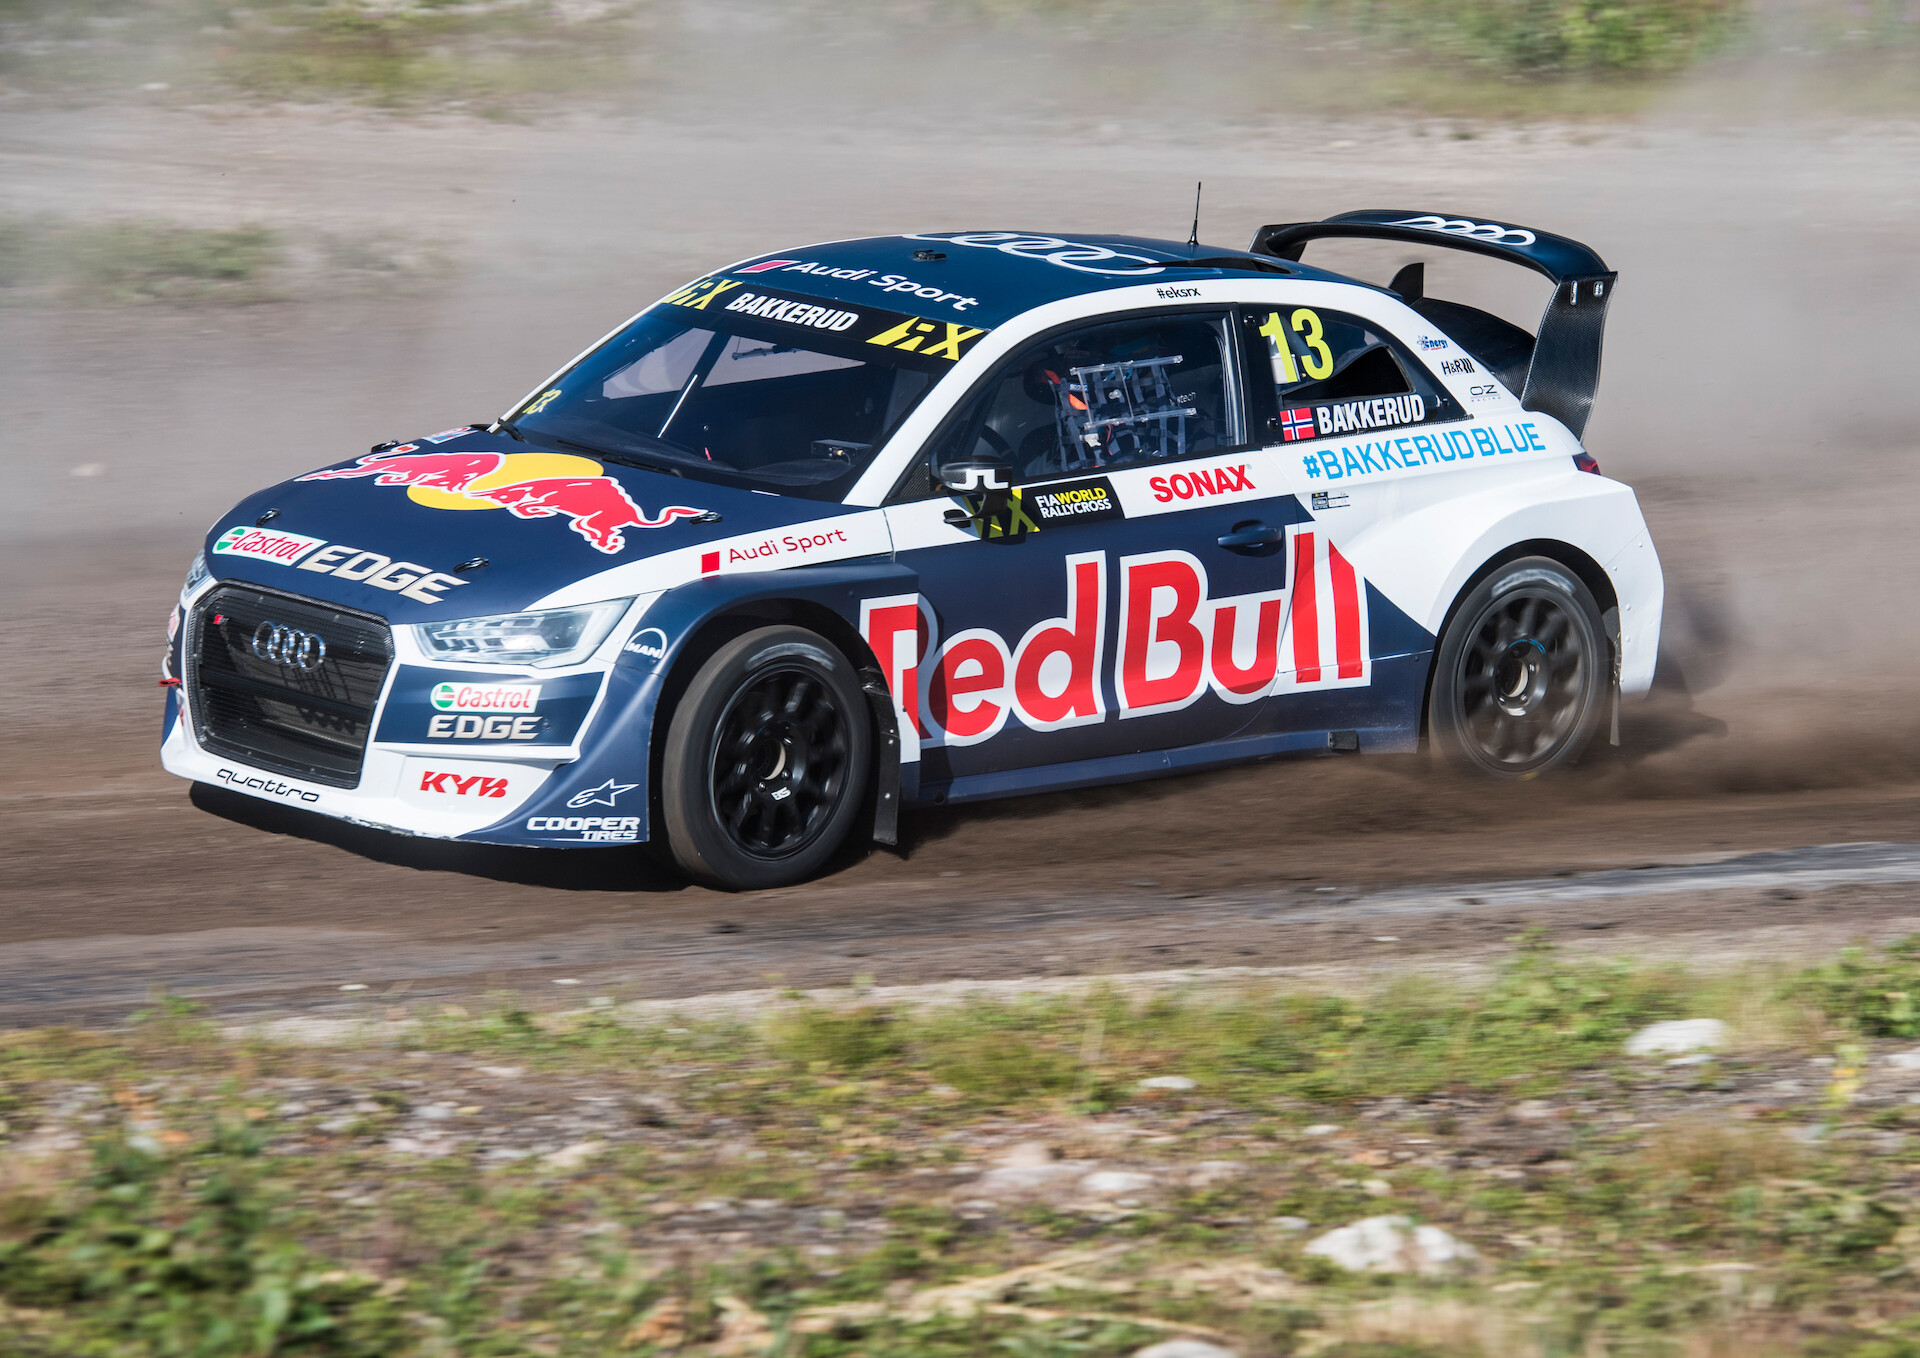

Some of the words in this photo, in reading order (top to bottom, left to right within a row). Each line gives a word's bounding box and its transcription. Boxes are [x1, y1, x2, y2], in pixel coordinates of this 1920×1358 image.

[781, 262, 878, 281] Audi
[867, 274, 979, 311] Sport
[1156, 286, 1202, 299] #eksrx
[724, 292, 860, 332] BAKKERUD
[1258, 308, 1334, 383] 13
[1316, 394, 1426, 435] BAKKERUD
[1150, 464, 1256, 503] SONAX
[1040, 499, 1113, 519] RALLYCROSS
[729, 540, 779, 563] Audi
[782, 529, 848, 553] Sport
[233, 531, 302, 561] Castrol
[297, 545, 471, 605] EDGE
[623, 642, 663, 659] MAN
[862, 555, 1104, 752] Red
[1119, 526, 1368, 716] Bull
[456, 686, 531, 709] Castrol
[427, 715, 543, 740] EDGE
[217, 768, 320, 803] quattro
[420, 771, 509, 798] KYB
[526, 816, 641, 831] COOPER
[580, 830, 639, 841] TIRES
